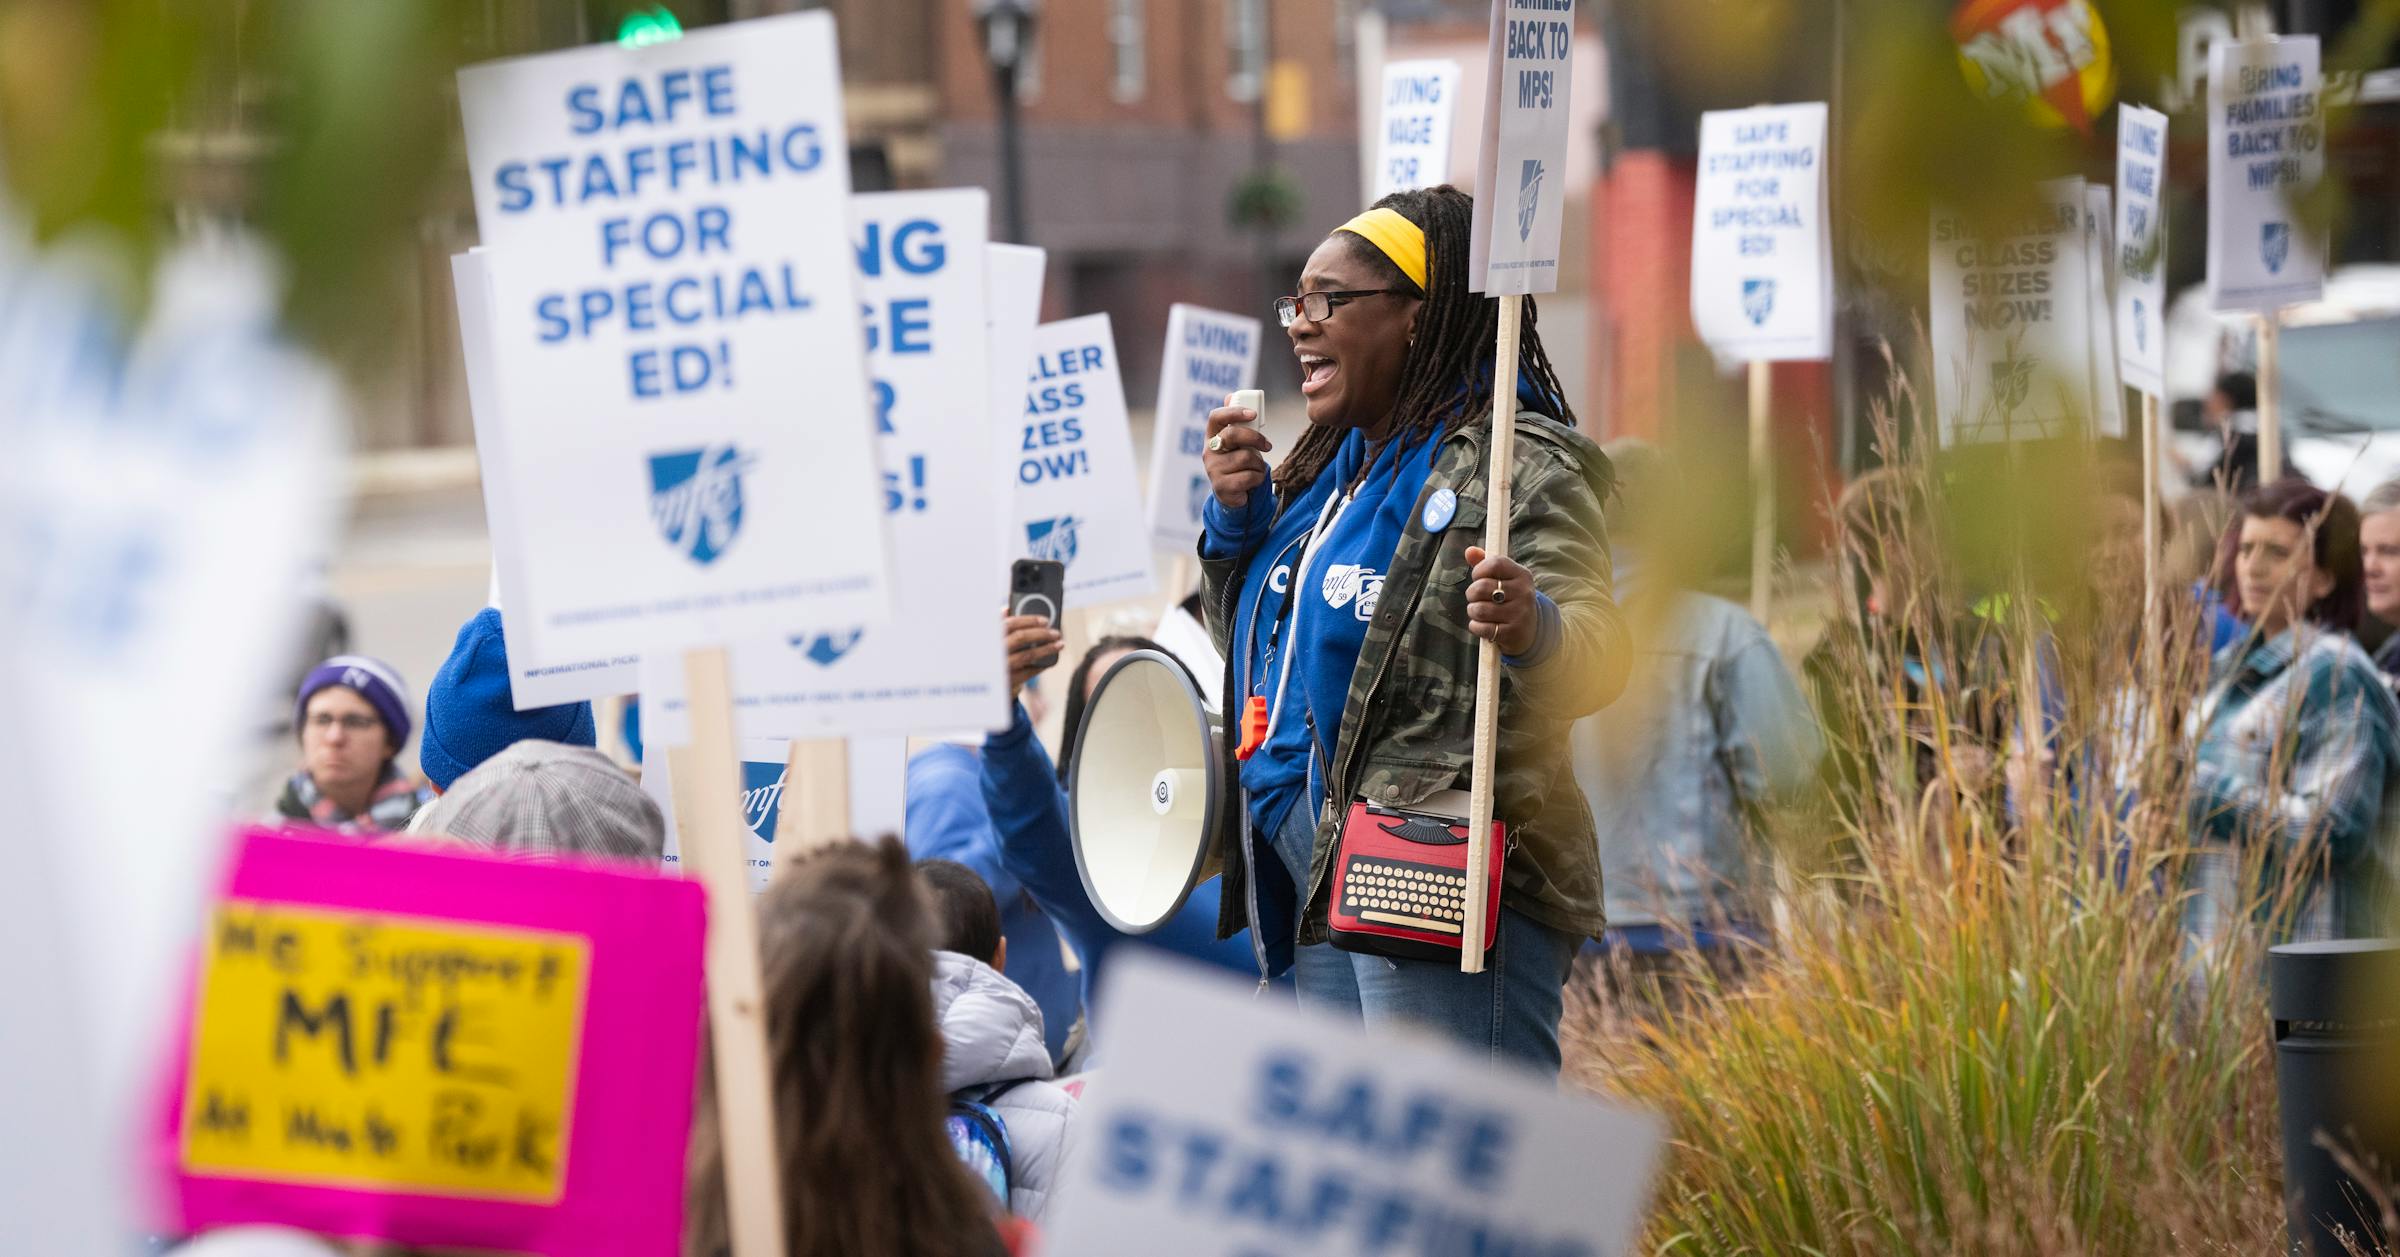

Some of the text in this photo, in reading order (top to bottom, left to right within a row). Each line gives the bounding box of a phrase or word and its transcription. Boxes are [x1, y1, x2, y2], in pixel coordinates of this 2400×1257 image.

[1508, 20, 1568, 60] BACK TO
[564, 62, 738, 137] SAFE
[1519, 70, 1553, 109] MPS!
[2226, 94, 2315, 126] FAMILIES
[1735, 119, 1790, 144] SAFE
[2227, 124, 2319, 158] BACK TO
[494, 123, 826, 213] STAFFING
[1710, 146, 1814, 176] STAFFING
[1735, 177, 1780, 199] FOR
[1711, 204, 1804, 230] SPECIAL
[600, 205, 733, 267] FOR
[1955, 241, 2056, 269] CLASS
[1962, 270, 2051, 297] SIZES
[534, 262, 813, 344] SPECIAL
[1964, 300, 2052, 331] NOW!
[627, 338, 736, 401] ED!
[523, 661, 609, 679] INFORMATIONAL
[1250, 1045, 1512, 1186] SAFE
